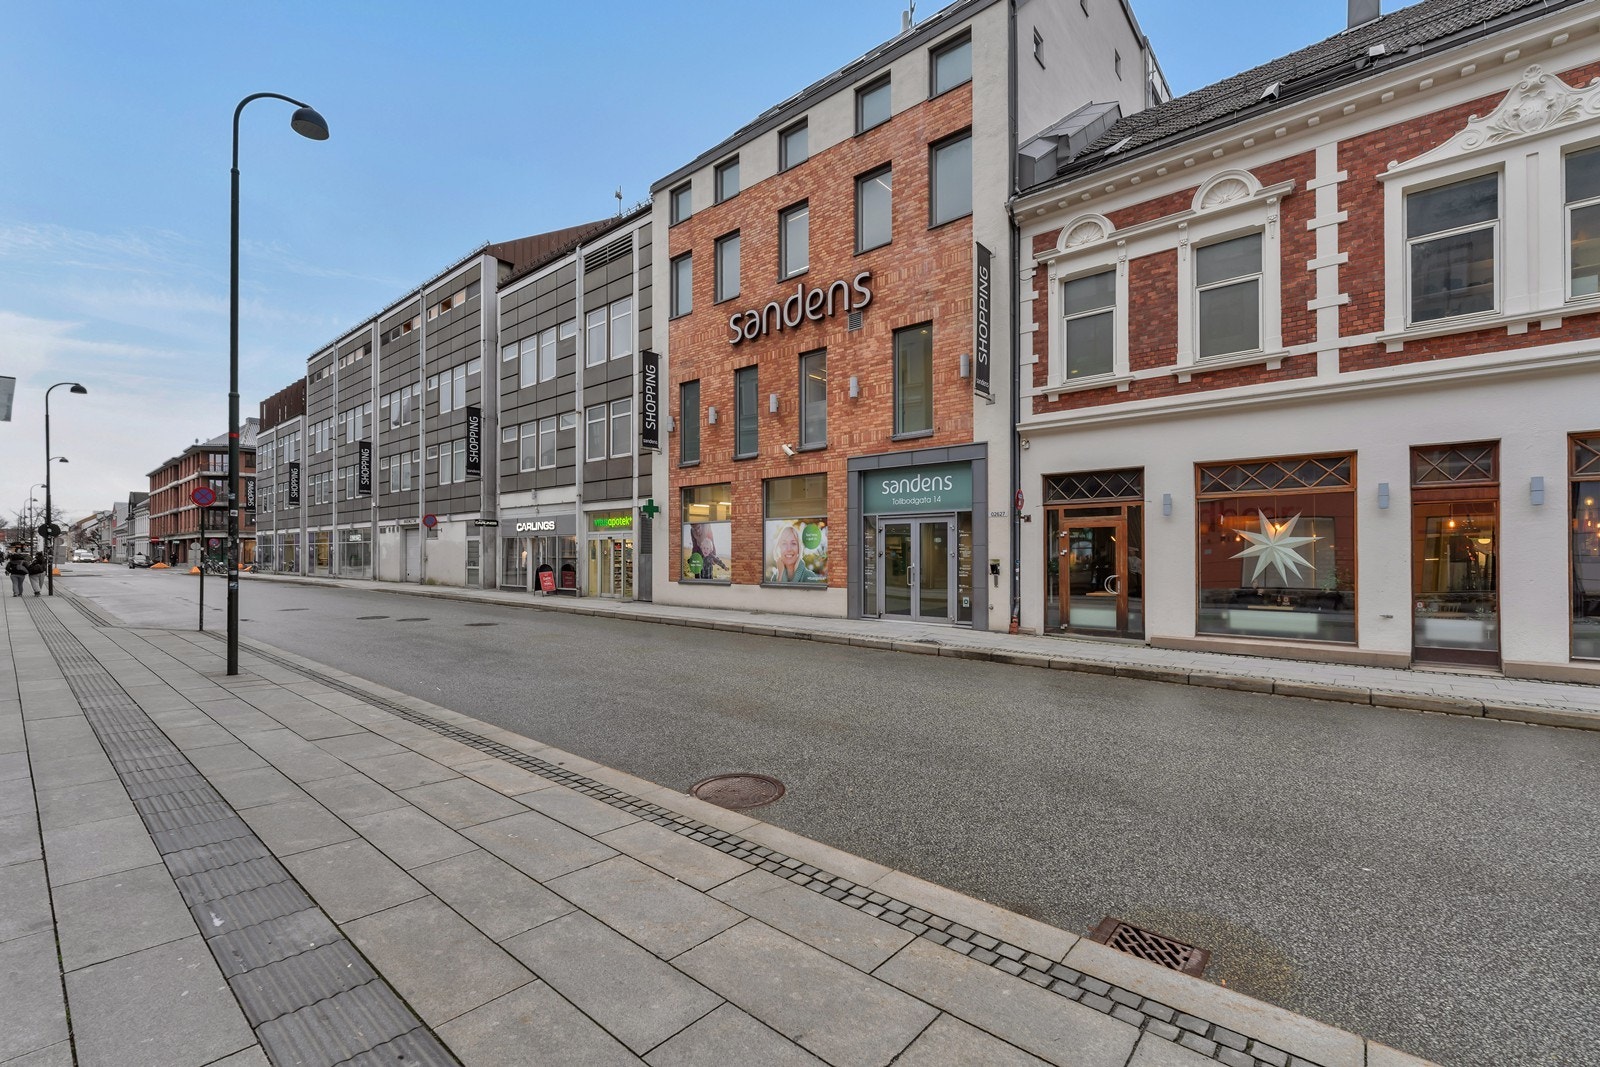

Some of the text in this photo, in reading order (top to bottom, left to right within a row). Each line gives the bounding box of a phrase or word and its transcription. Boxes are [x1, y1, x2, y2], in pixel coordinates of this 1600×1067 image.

[729, 271, 873, 345] sandens
[978, 266, 989, 366] SHOPPING
[645, 364, 657, 431] SHOPPING
[469, 416, 479, 464] SHOPPING
[290, 467, 299, 498] SHOPPING
[361, 448, 370, 485] SHOPPING
[247, 480, 255, 507] SHOPPING
[881, 473, 953, 495] sandens
[892, 495, 942, 506] Tollbodgata 14
[516, 520, 556, 532] CARLINGS
